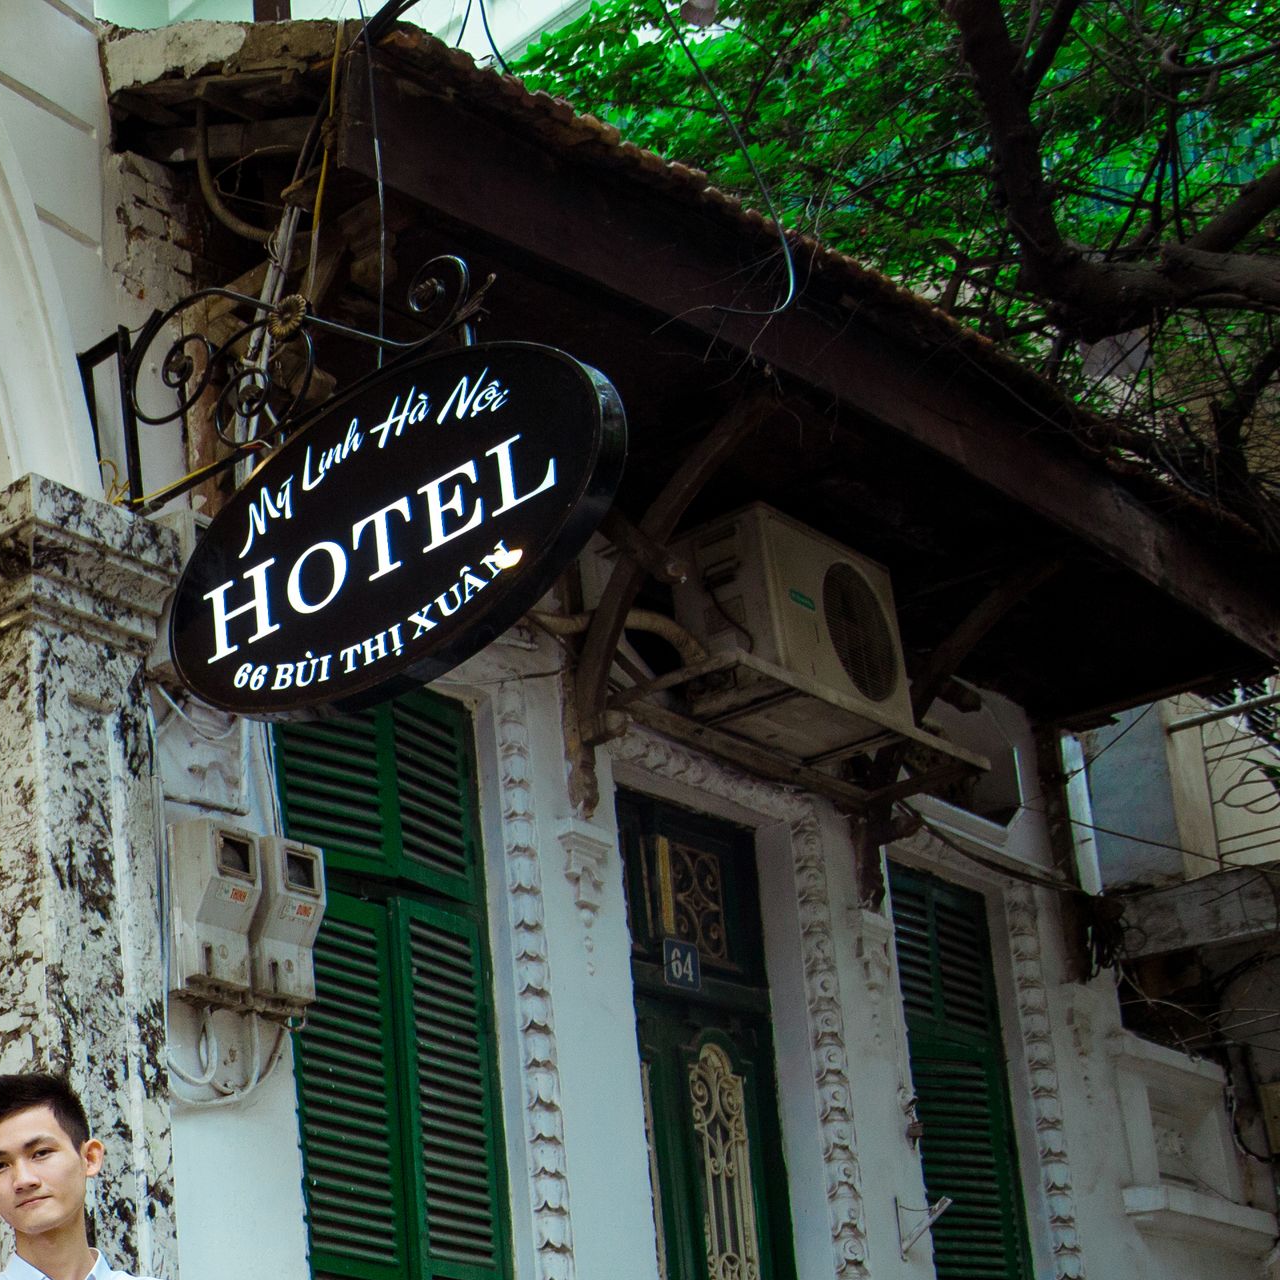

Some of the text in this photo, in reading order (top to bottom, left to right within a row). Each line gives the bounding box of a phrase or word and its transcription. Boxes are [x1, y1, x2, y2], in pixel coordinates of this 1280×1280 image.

[301, 417, 365, 492] Linh
[369, 385, 432, 449] Hà
[436, 367, 510, 425] Nội
[202, 434, 558, 665] HOTEL
[233, 539, 517, 691] 66 BÙI THỊ XUÂN
[671, 947, 694, 982] 64
